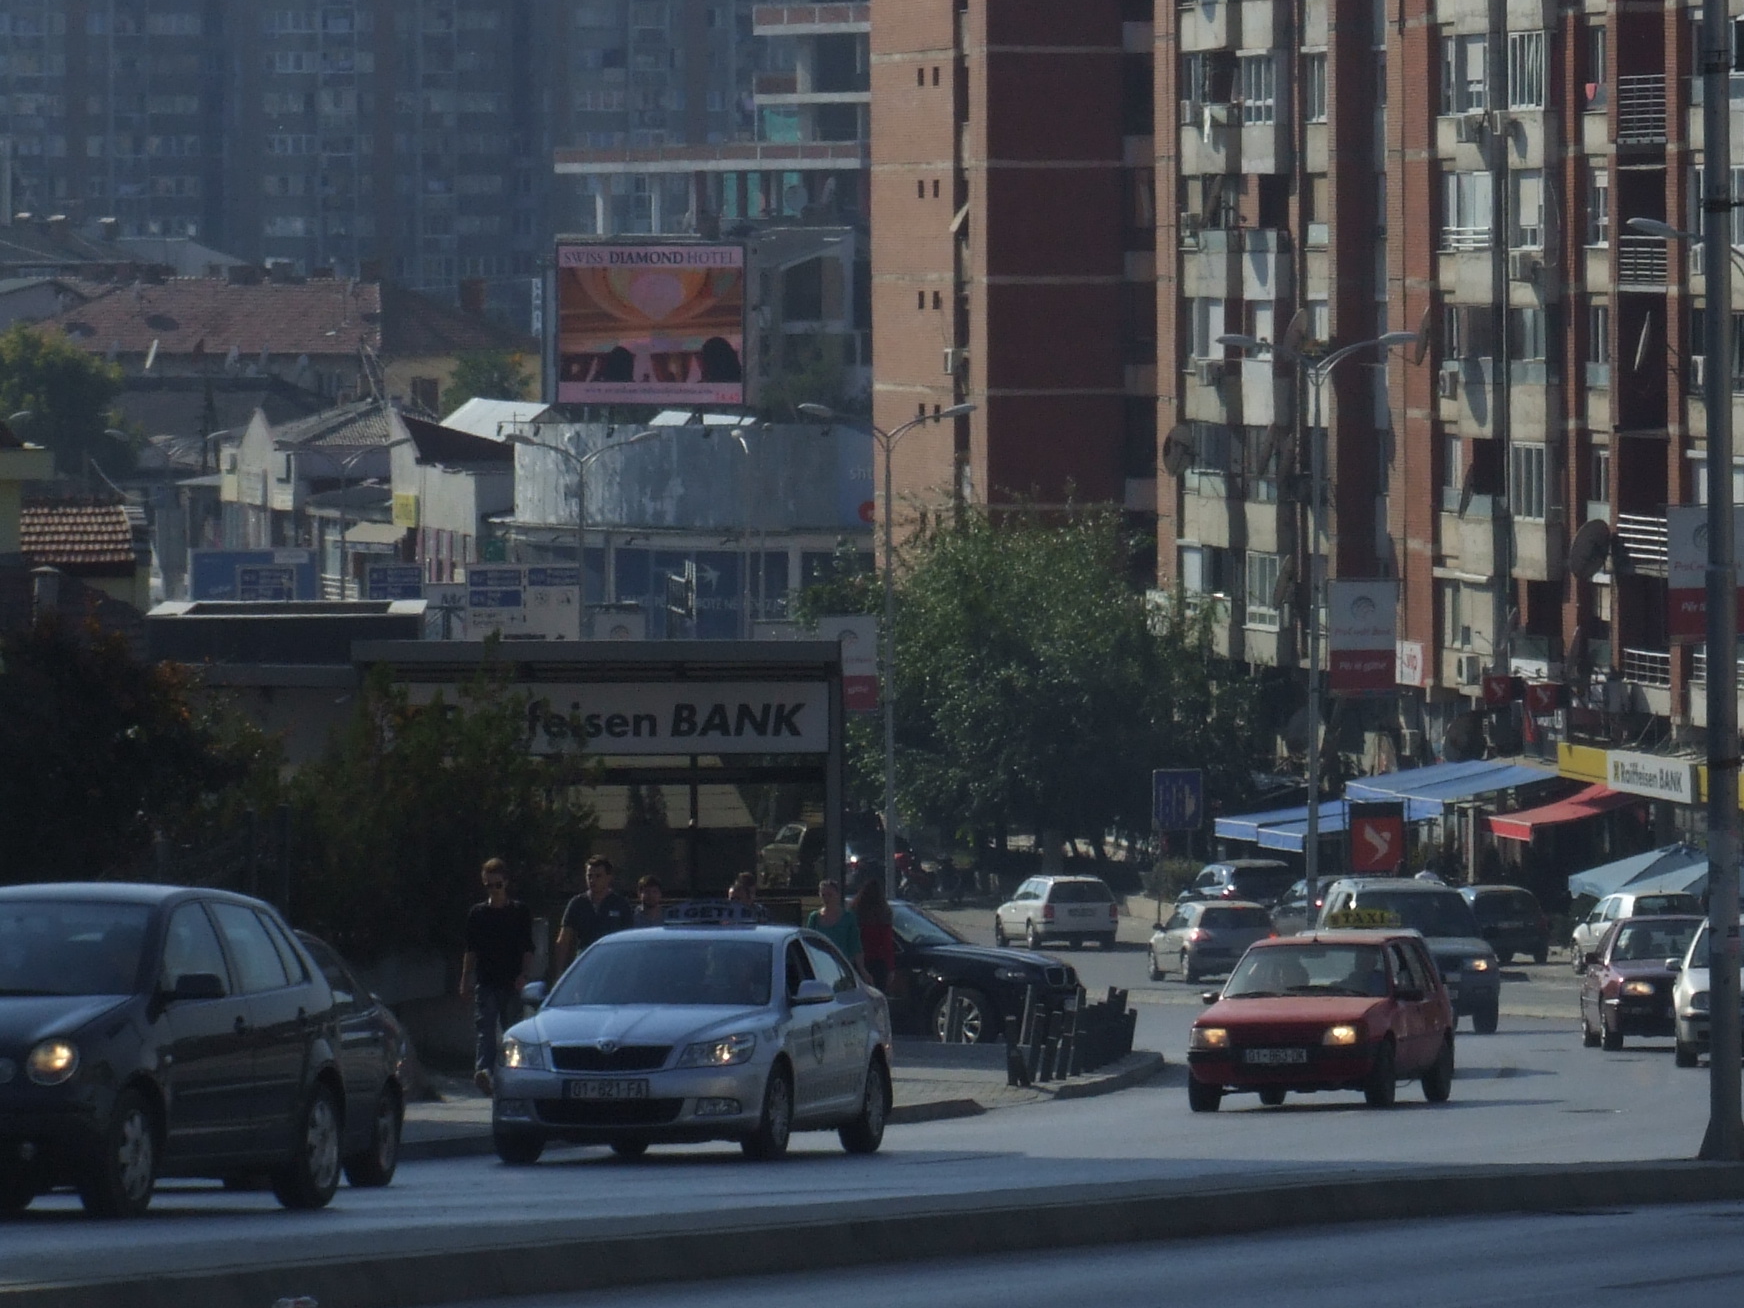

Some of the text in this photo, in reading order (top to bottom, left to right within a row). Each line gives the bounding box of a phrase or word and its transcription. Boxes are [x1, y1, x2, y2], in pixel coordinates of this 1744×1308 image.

[564, 250, 739, 266] SWISS DIAMOND HOTEL
[670, 703, 806, 738] BANK
[1659, 768, 1683, 794] BANK
[1342, 912, 1386, 925] TAXI
